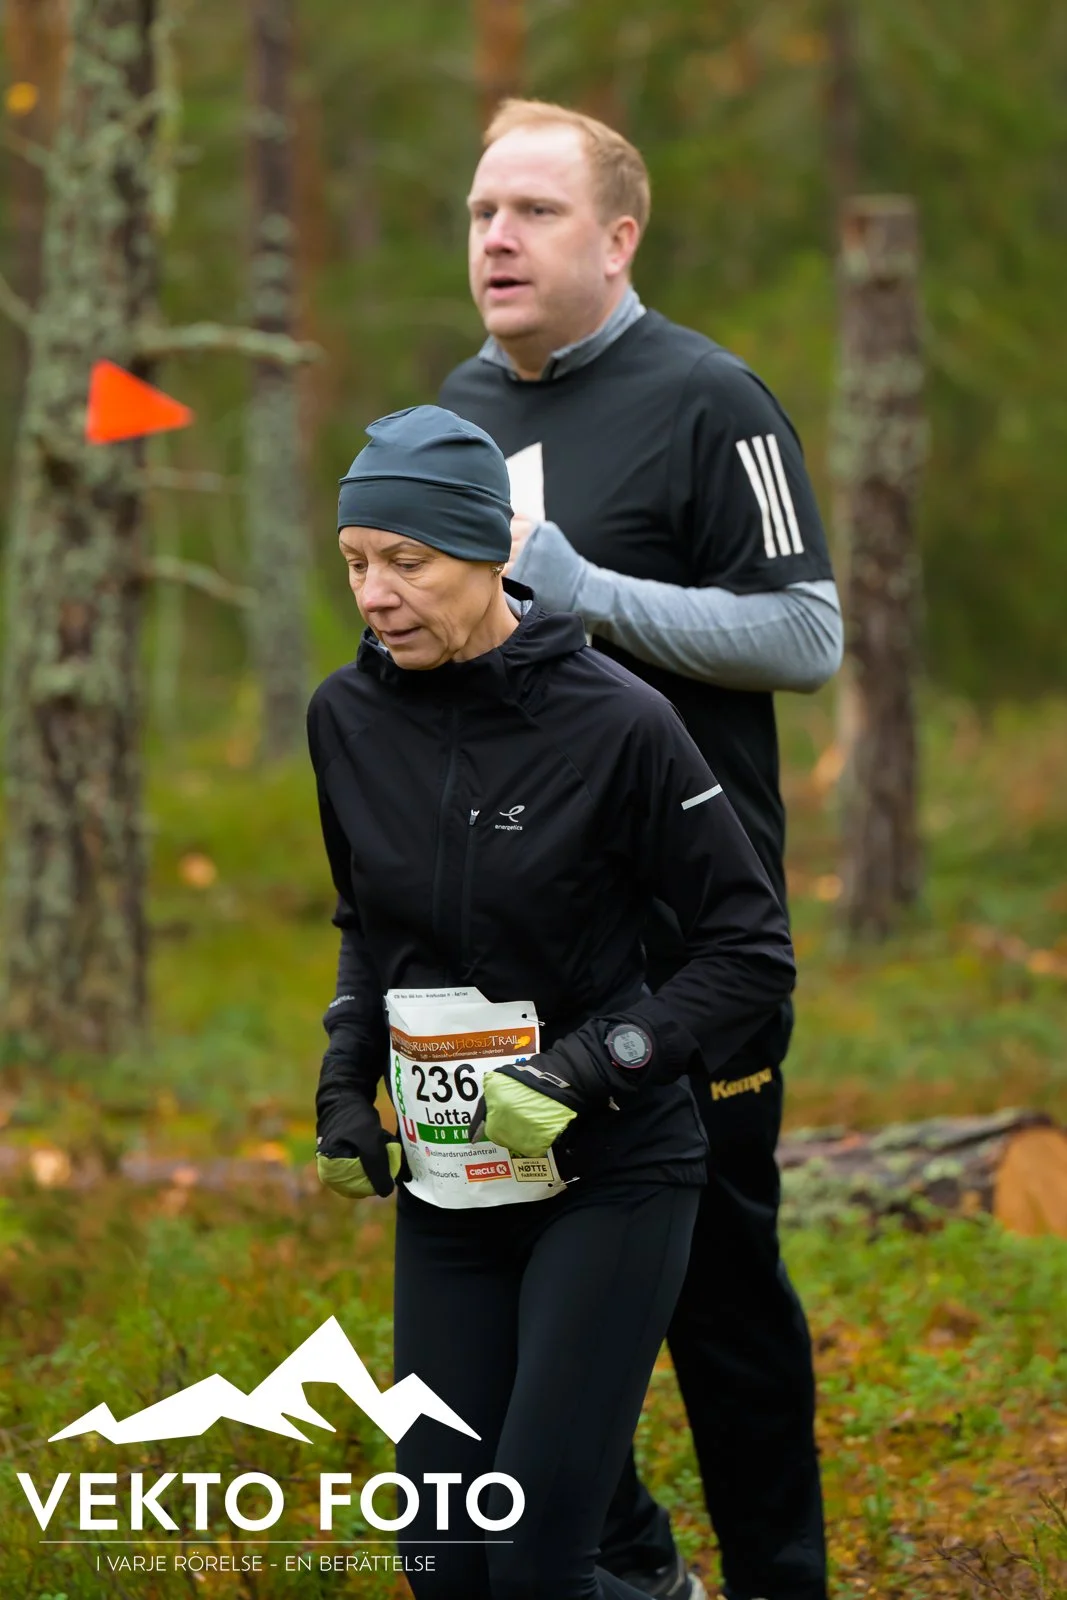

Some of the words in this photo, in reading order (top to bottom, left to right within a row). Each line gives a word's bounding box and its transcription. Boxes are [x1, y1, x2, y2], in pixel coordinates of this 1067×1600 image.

[411, 1063, 479, 1101] 236
[425, 1107, 472, 1125] Lotta
[434, 1129, 446, 1140] 10
[453, 1129, 469, 1140] KM
[469, 1166, 496, 1176] CIRCLE
[517, 1164, 548, 1173] NØTTE
